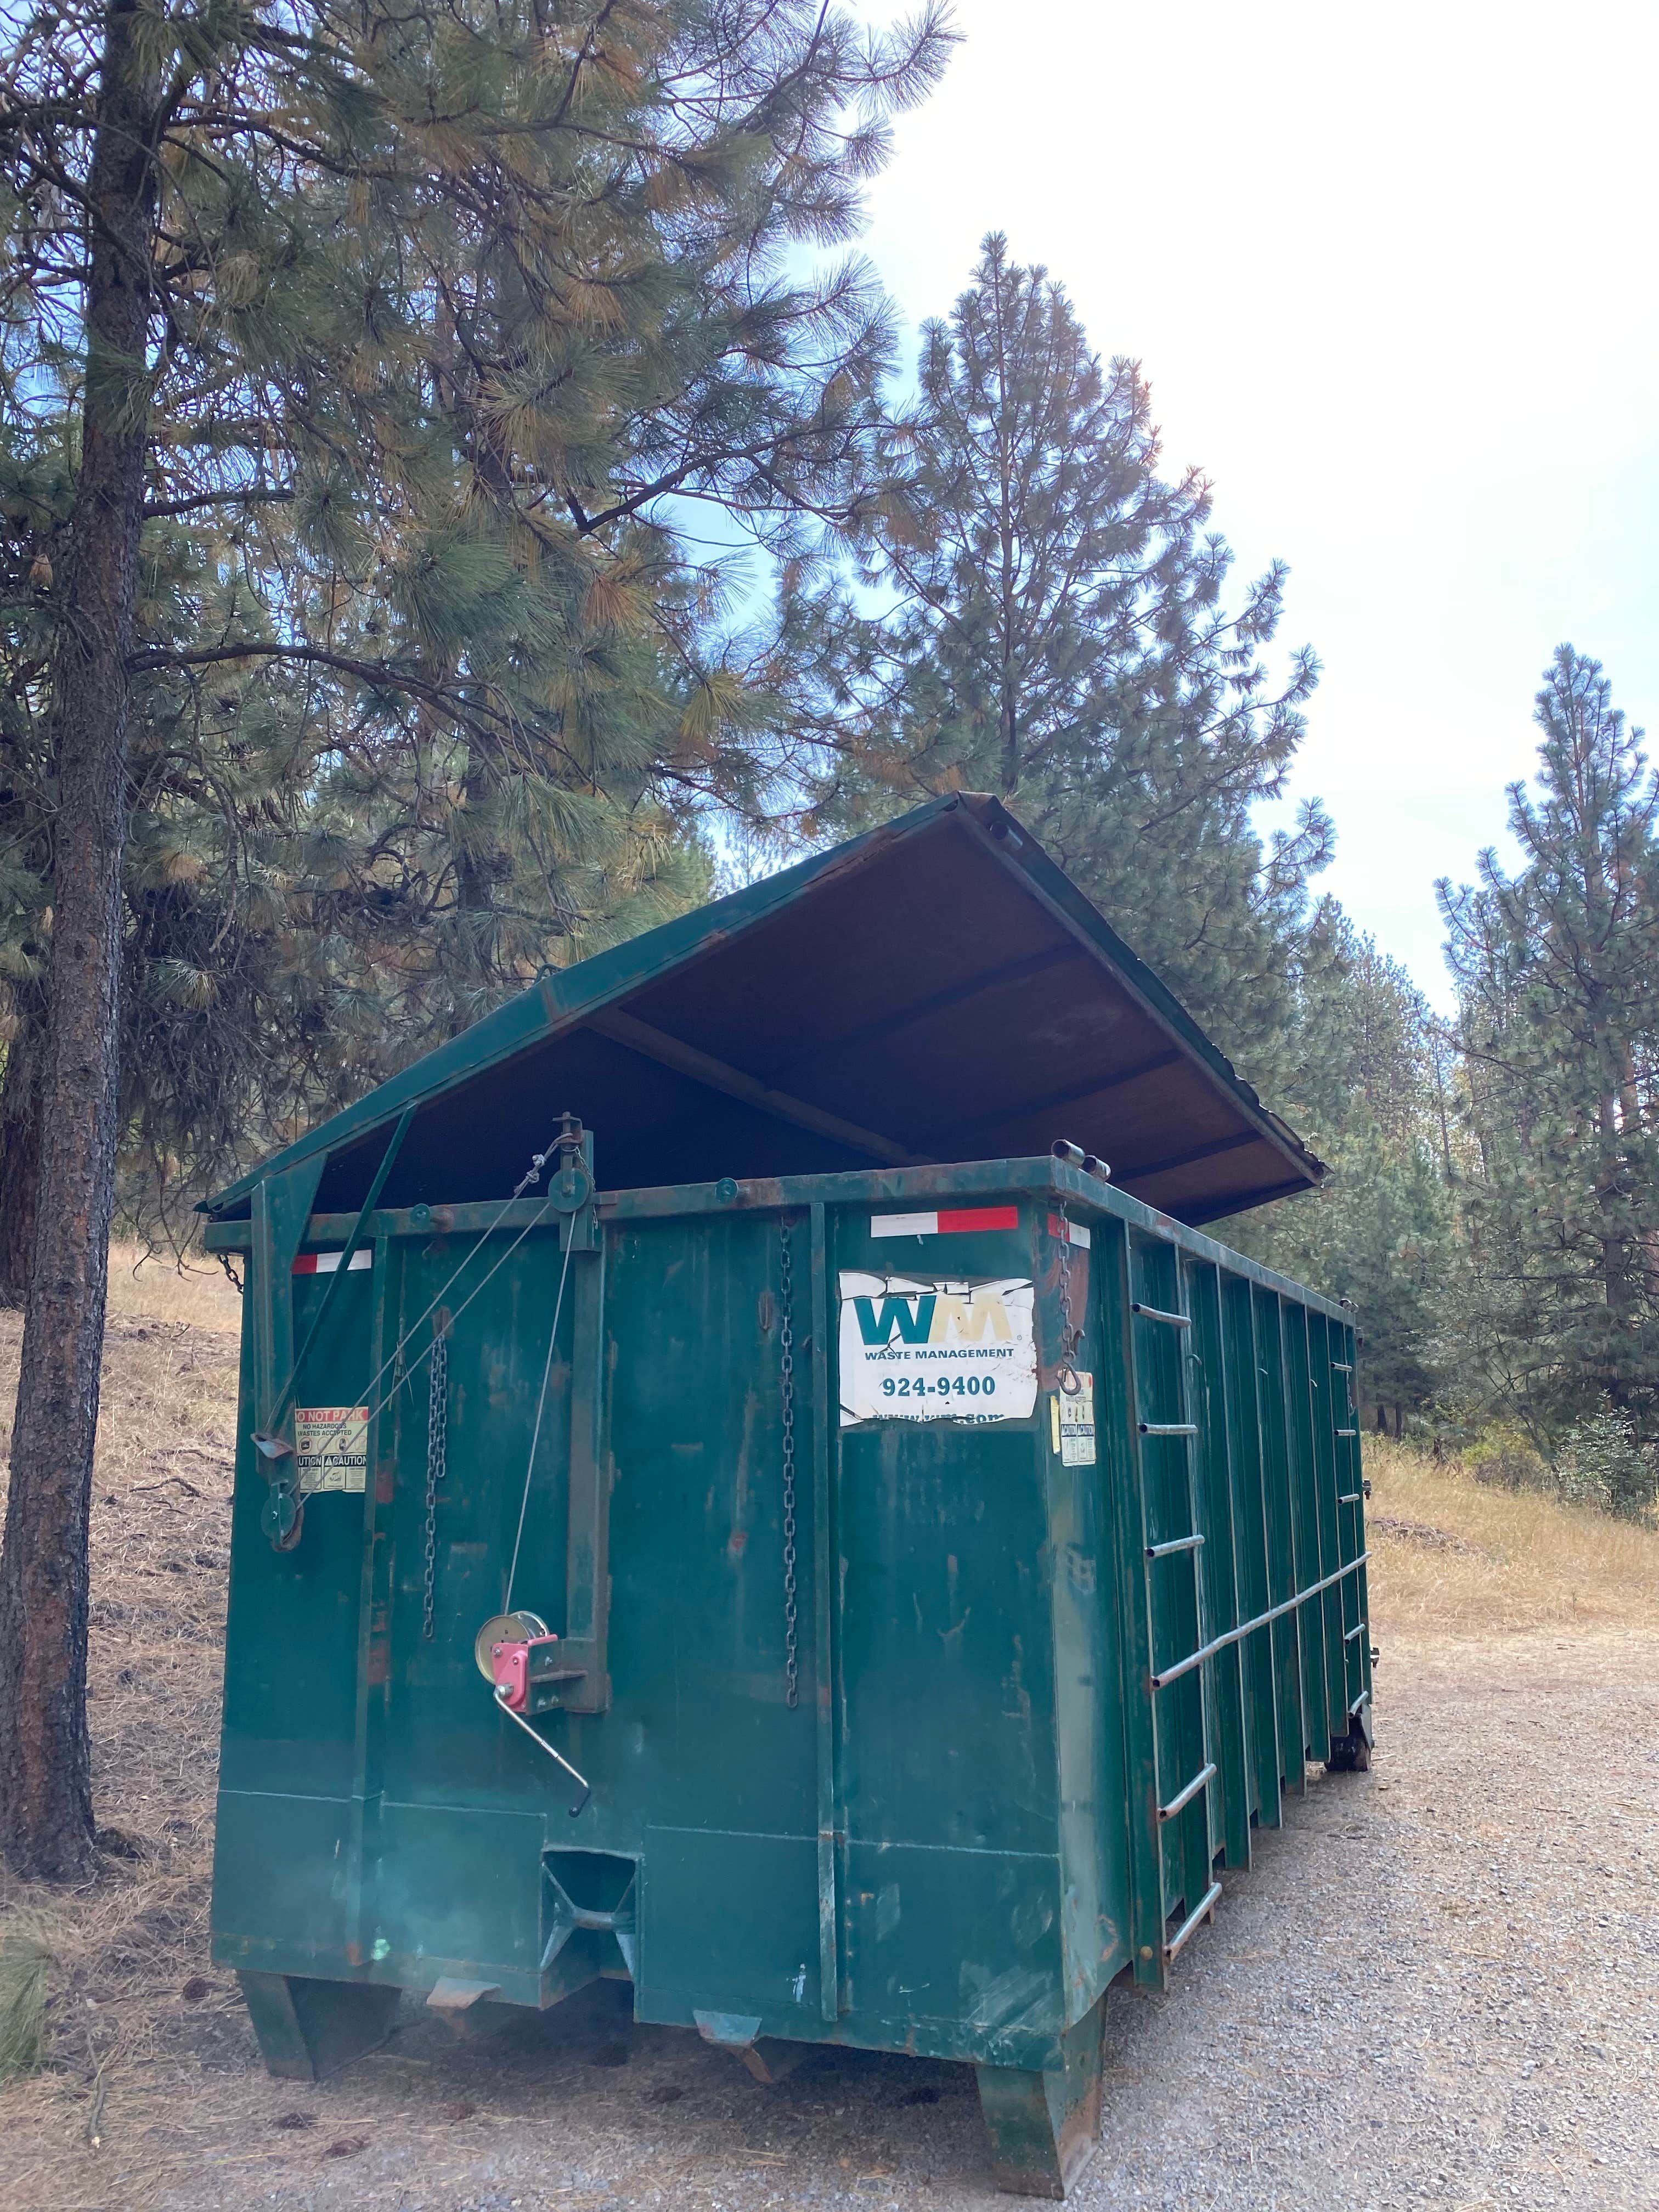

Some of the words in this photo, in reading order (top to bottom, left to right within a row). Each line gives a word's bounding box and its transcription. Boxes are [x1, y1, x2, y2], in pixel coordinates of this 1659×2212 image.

[854, 1293, 1013, 1346] WM
[865, 1351, 911, 1361] WASTE
[915, 1348, 1014, 1359] MANAGEMENT
[882, 1376, 995, 1397] 924-9400
[308, 1410, 331, 1422] NOT
[298, 1457, 321, 1466] UTION
[332, 1455, 366, 1465] CAUTION
